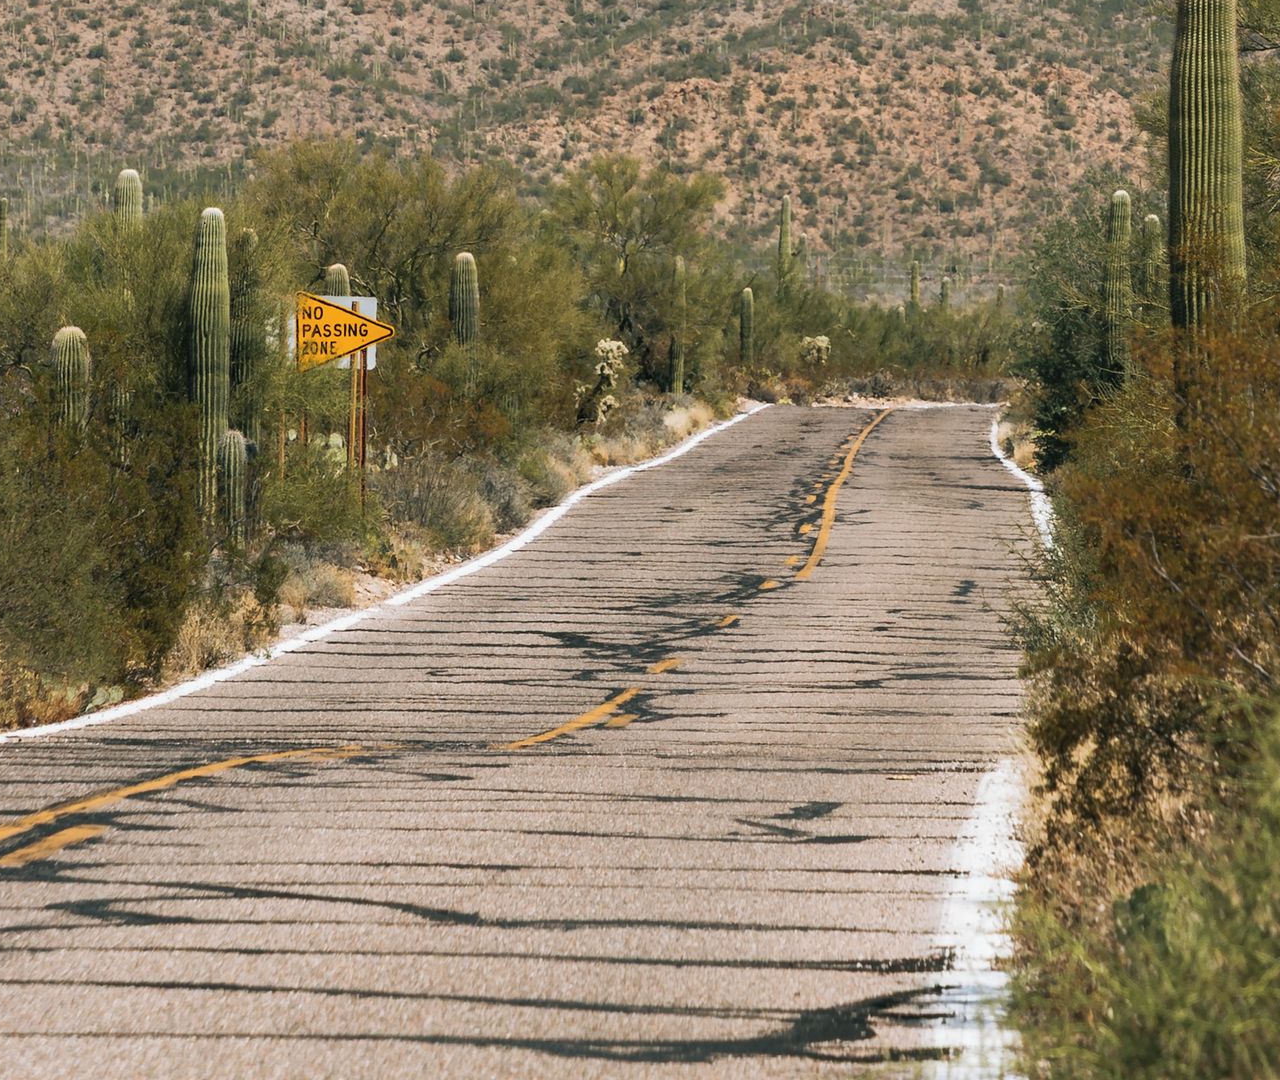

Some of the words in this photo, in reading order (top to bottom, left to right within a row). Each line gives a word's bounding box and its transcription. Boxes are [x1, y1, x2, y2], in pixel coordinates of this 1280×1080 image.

[302, 306, 323, 320] NO
[302, 323, 368, 337] PASSING
[302, 341, 337, 355] ZONE
